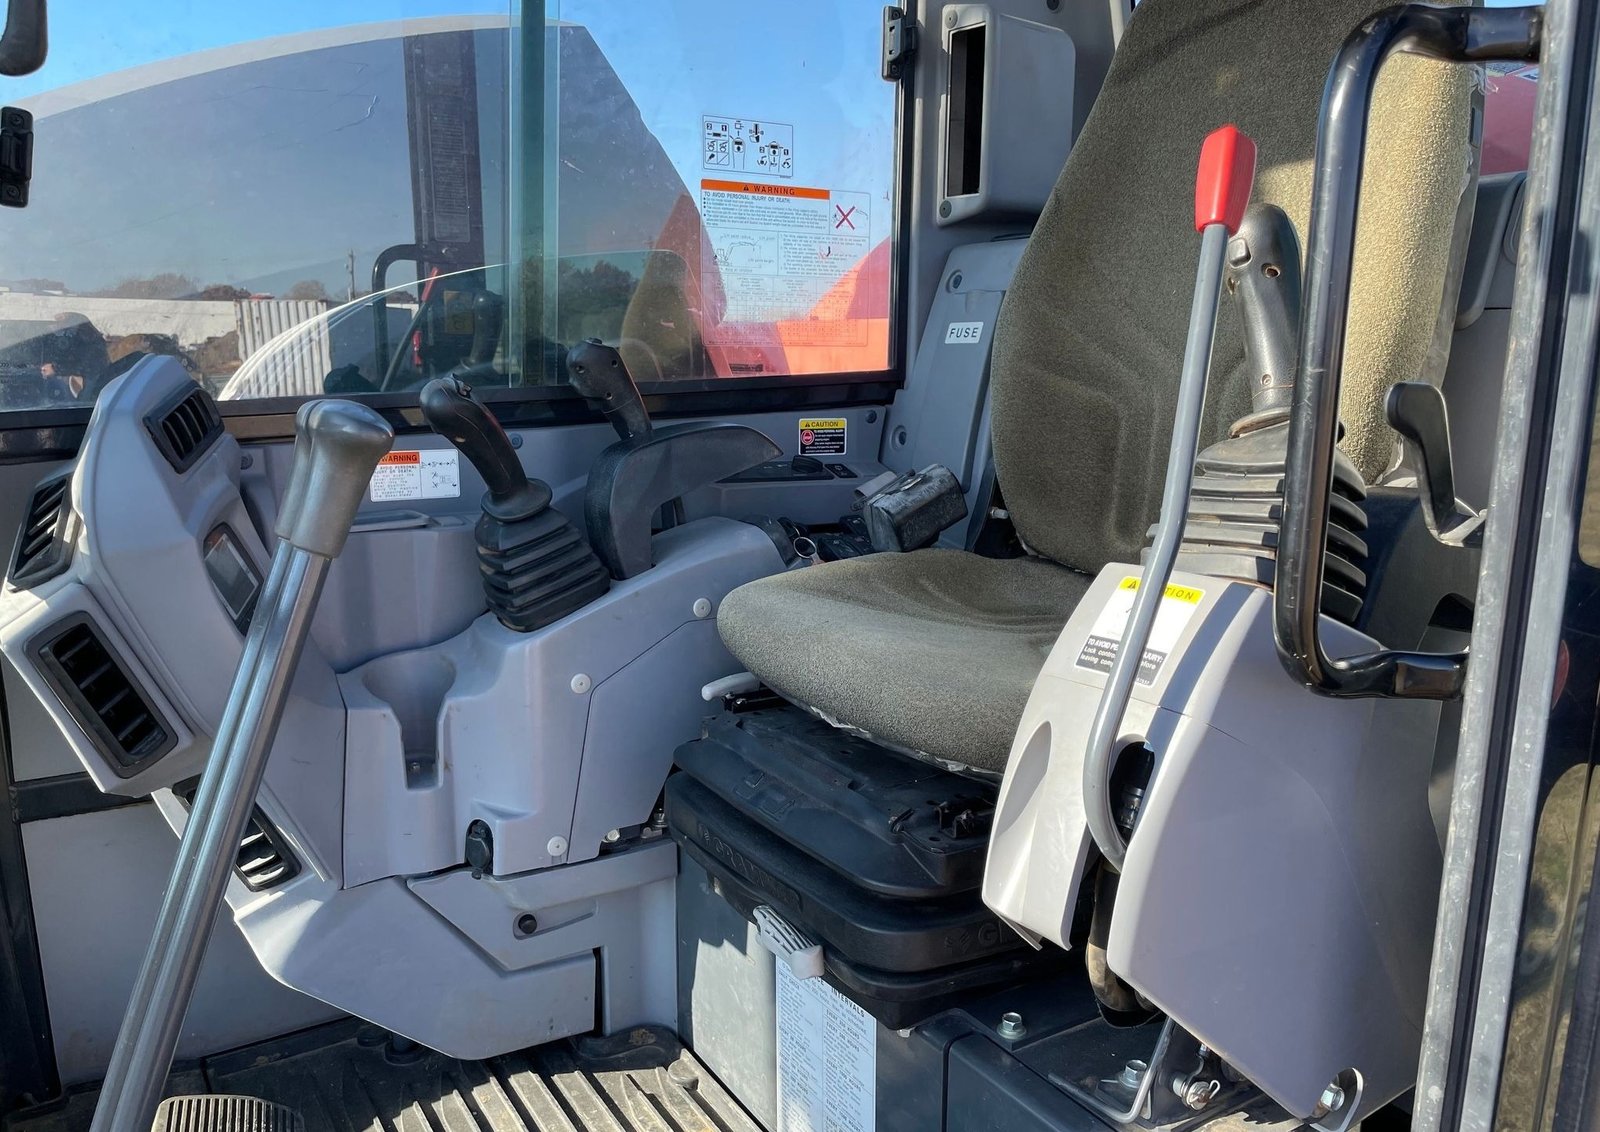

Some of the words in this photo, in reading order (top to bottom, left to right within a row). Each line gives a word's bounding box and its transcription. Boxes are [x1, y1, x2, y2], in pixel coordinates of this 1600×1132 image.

[753, 185, 795, 195] WARNING
[949, 327, 979, 338] FUSE
[1095, 640, 1111, 649] AVOID
[1084, 646, 1097, 654] Lock
[1080, 653, 1099, 664] leaving
[831, 987, 865, 1018] INTERVALS
